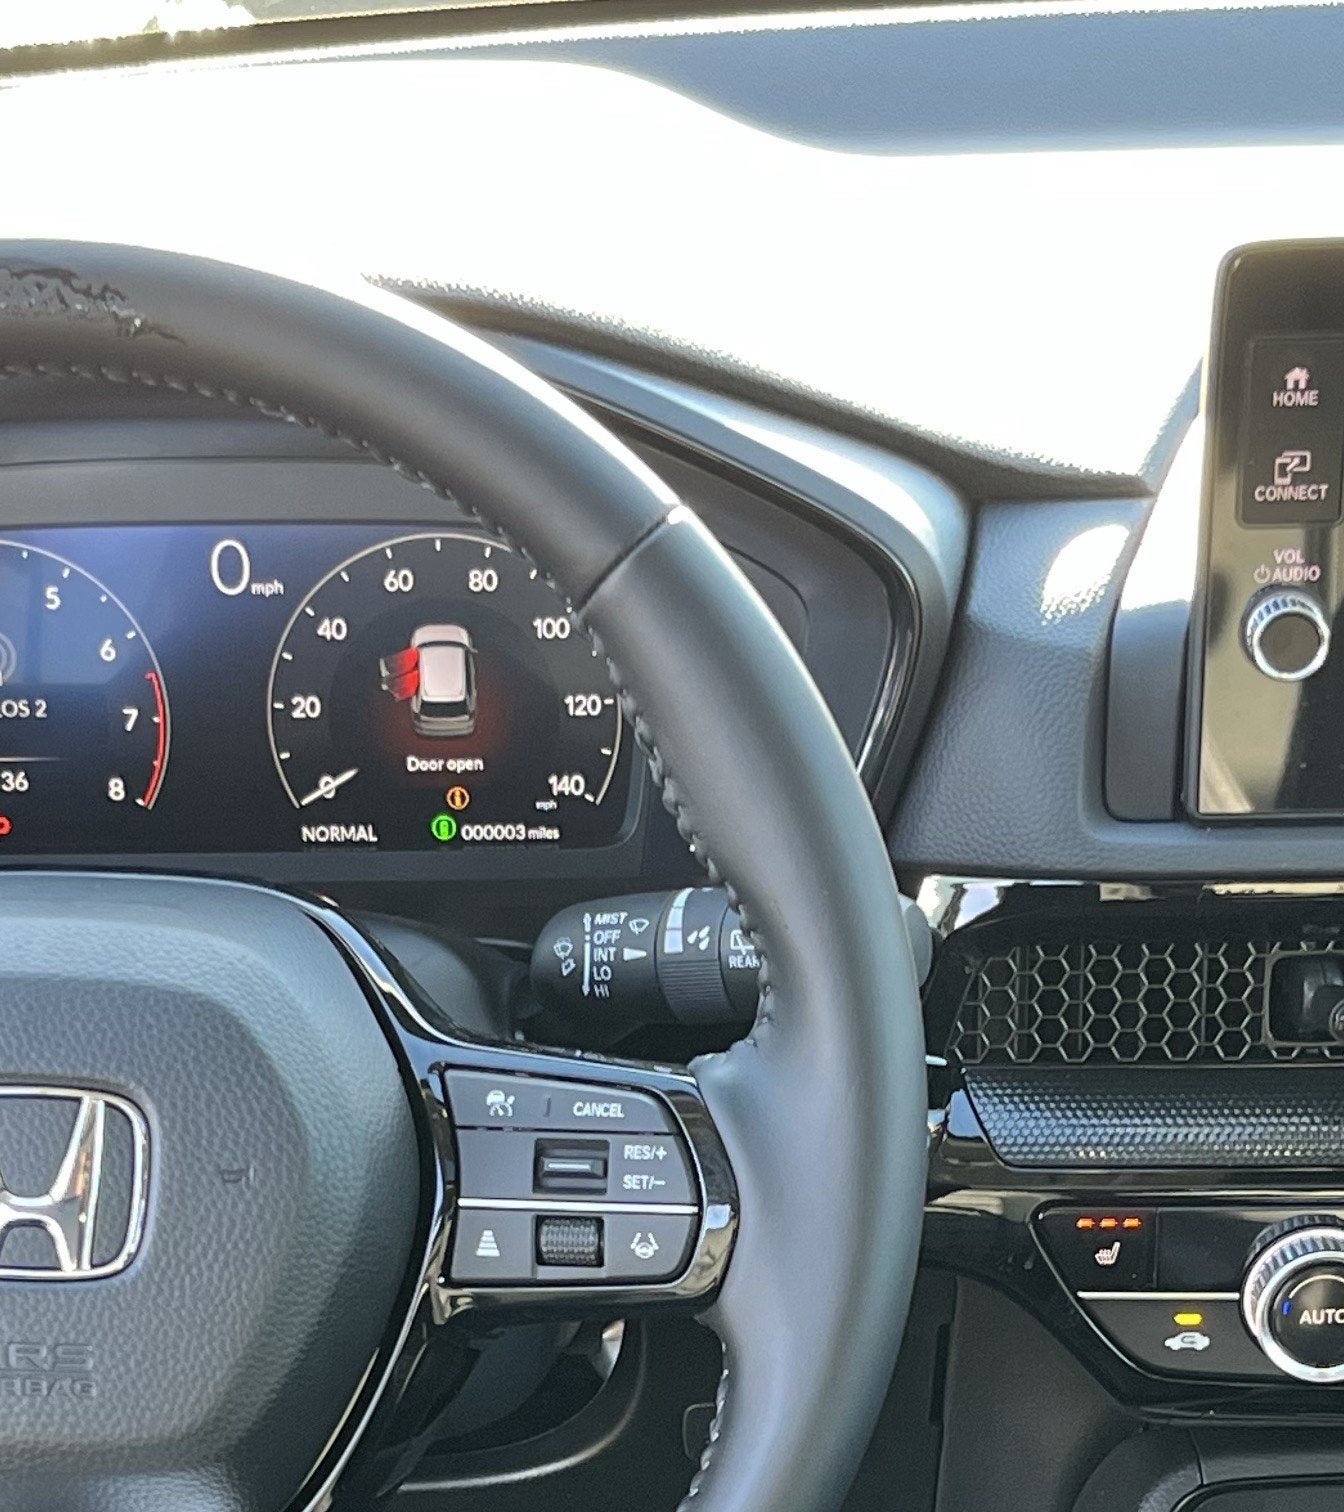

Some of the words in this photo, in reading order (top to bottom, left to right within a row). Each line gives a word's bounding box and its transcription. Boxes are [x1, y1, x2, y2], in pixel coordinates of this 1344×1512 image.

[1272, 390, 1319, 408] HOME
[1254, 483, 1329, 501] CONNECT
[1273, 548, 1306, 565] VOL
[210, 538, 251, 597] 0
[251, 580, 284, 597] mph
[1271, 565, 1321, 582] AUDIO
[384, 569, 414, 593] 60
[468, 569, 498, 592] 80
[44, 586, 62, 611] 5
[316, 618, 347, 641] 40
[532, 617, 571, 640] 100
[100, 638, 117, 661] 6
[34, 699, 48, 719] 2
[291, 696, 322, 719] 20
[565, 693, 602, 717] 120
[122, 708, 139, 731] 7
[406, 756, 444, 773] Door
[446, 757, 484, 777] open
[108, 777, 125, 801] 8
[548, 774, 585, 798] 140
[301, 826, 378, 843] NORMAL
[461, 824, 526, 841] 000003
[527, 825, 560, 840] miles
[594, 911, 628, 926] MIST
[593, 930, 621, 945] OFF
[593, 949, 617, 963] INT
[592, 965, 613, 982] LO
[593, 984, 610, 998] HI
[572, 1102, 625, 1119] CANCEL
[623, 1144, 667, 1161] RES/+
